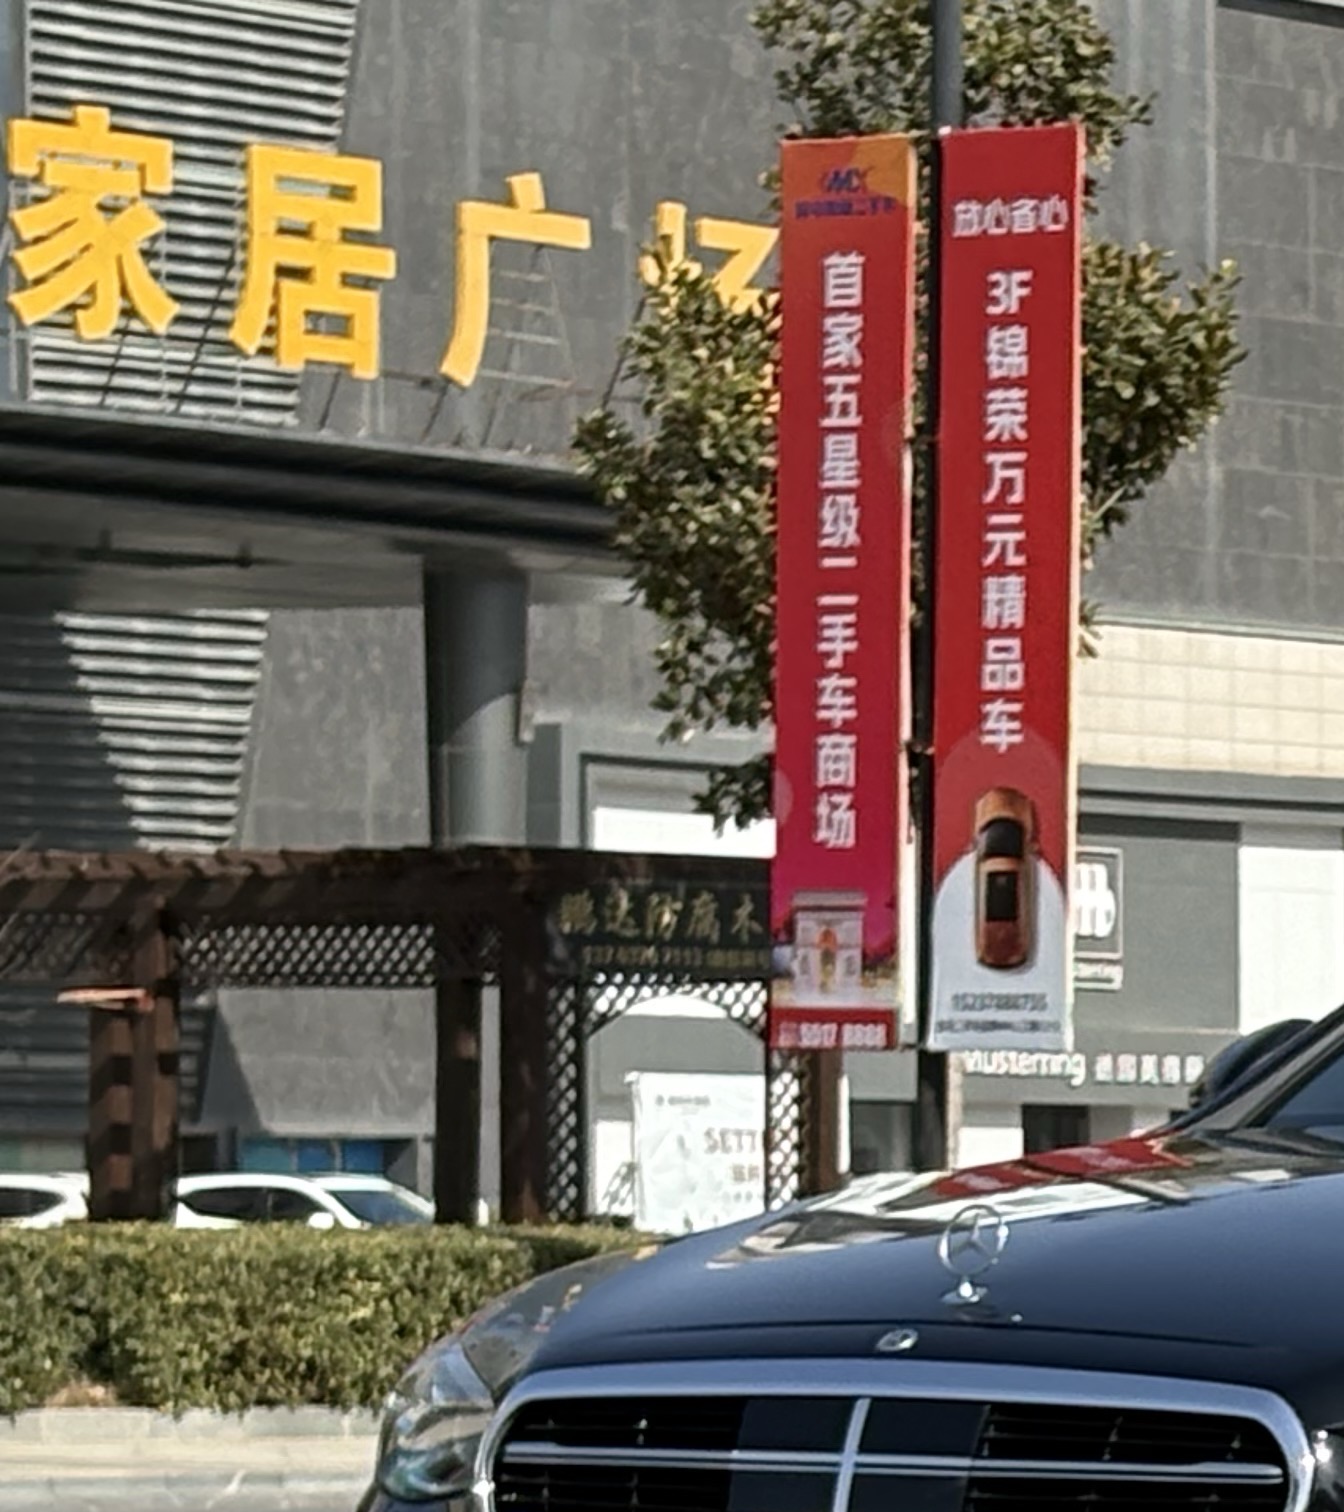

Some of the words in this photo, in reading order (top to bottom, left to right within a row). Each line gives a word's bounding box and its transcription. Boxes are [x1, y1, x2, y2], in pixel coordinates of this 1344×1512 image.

[952, 194, 1069, 238] 放心省心
[814, 250, 866, 849] 首家五星级二手车商场
